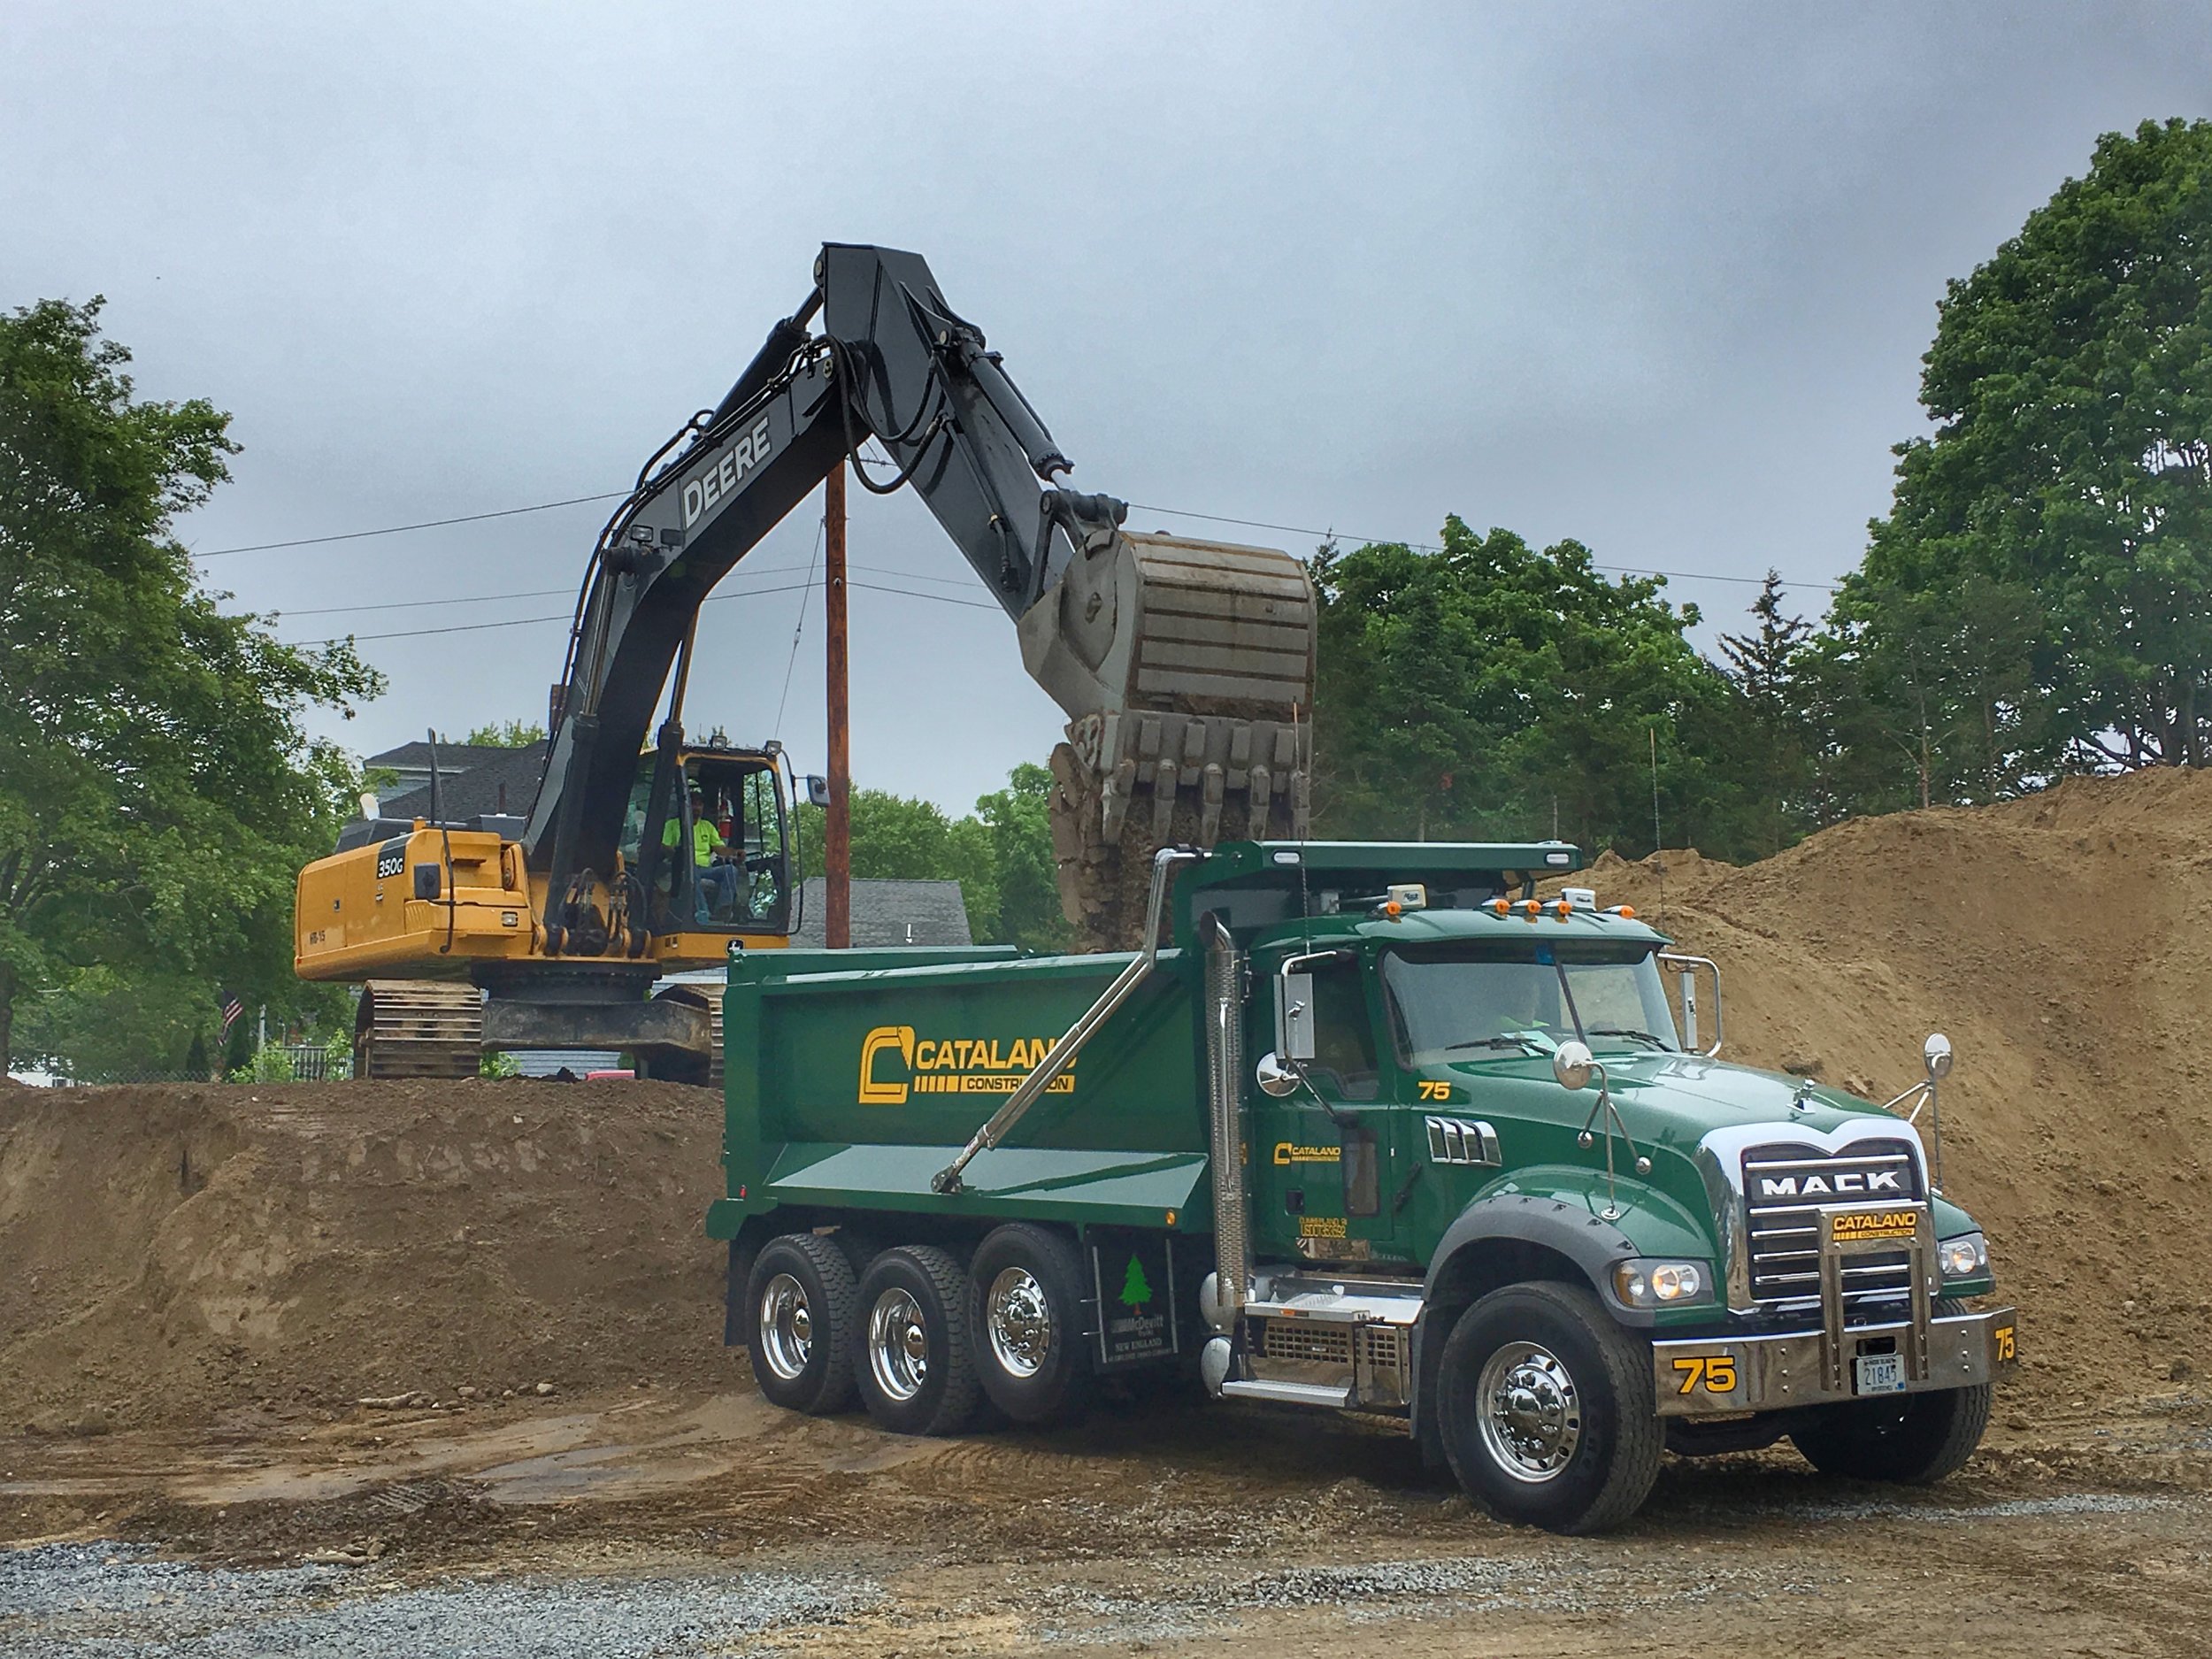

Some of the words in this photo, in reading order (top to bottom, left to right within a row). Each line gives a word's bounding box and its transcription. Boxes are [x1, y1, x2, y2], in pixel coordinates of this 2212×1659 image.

[683, 416, 771, 529] DEERE
[378, 857, 403, 878] 350G
[916, 1038, 1077, 1070] CATALAN
[966, 1077, 1069, 1090] CONSTRON
[1418, 1081, 1450, 1100] 75
[1293, 1147, 1340, 1156] CATALANO
[1761, 1171, 1901, 1195] MACK
[1833, 1212, 1916, 1231] CATALANO
[1861, 1229, 1912, 1238] CONSTRUCTION
[1995, 1326, 2015, 1362] 75
[1673, 1356, 1736, 1394] 75
[1864, 1365, 1897, 1386] 21845
